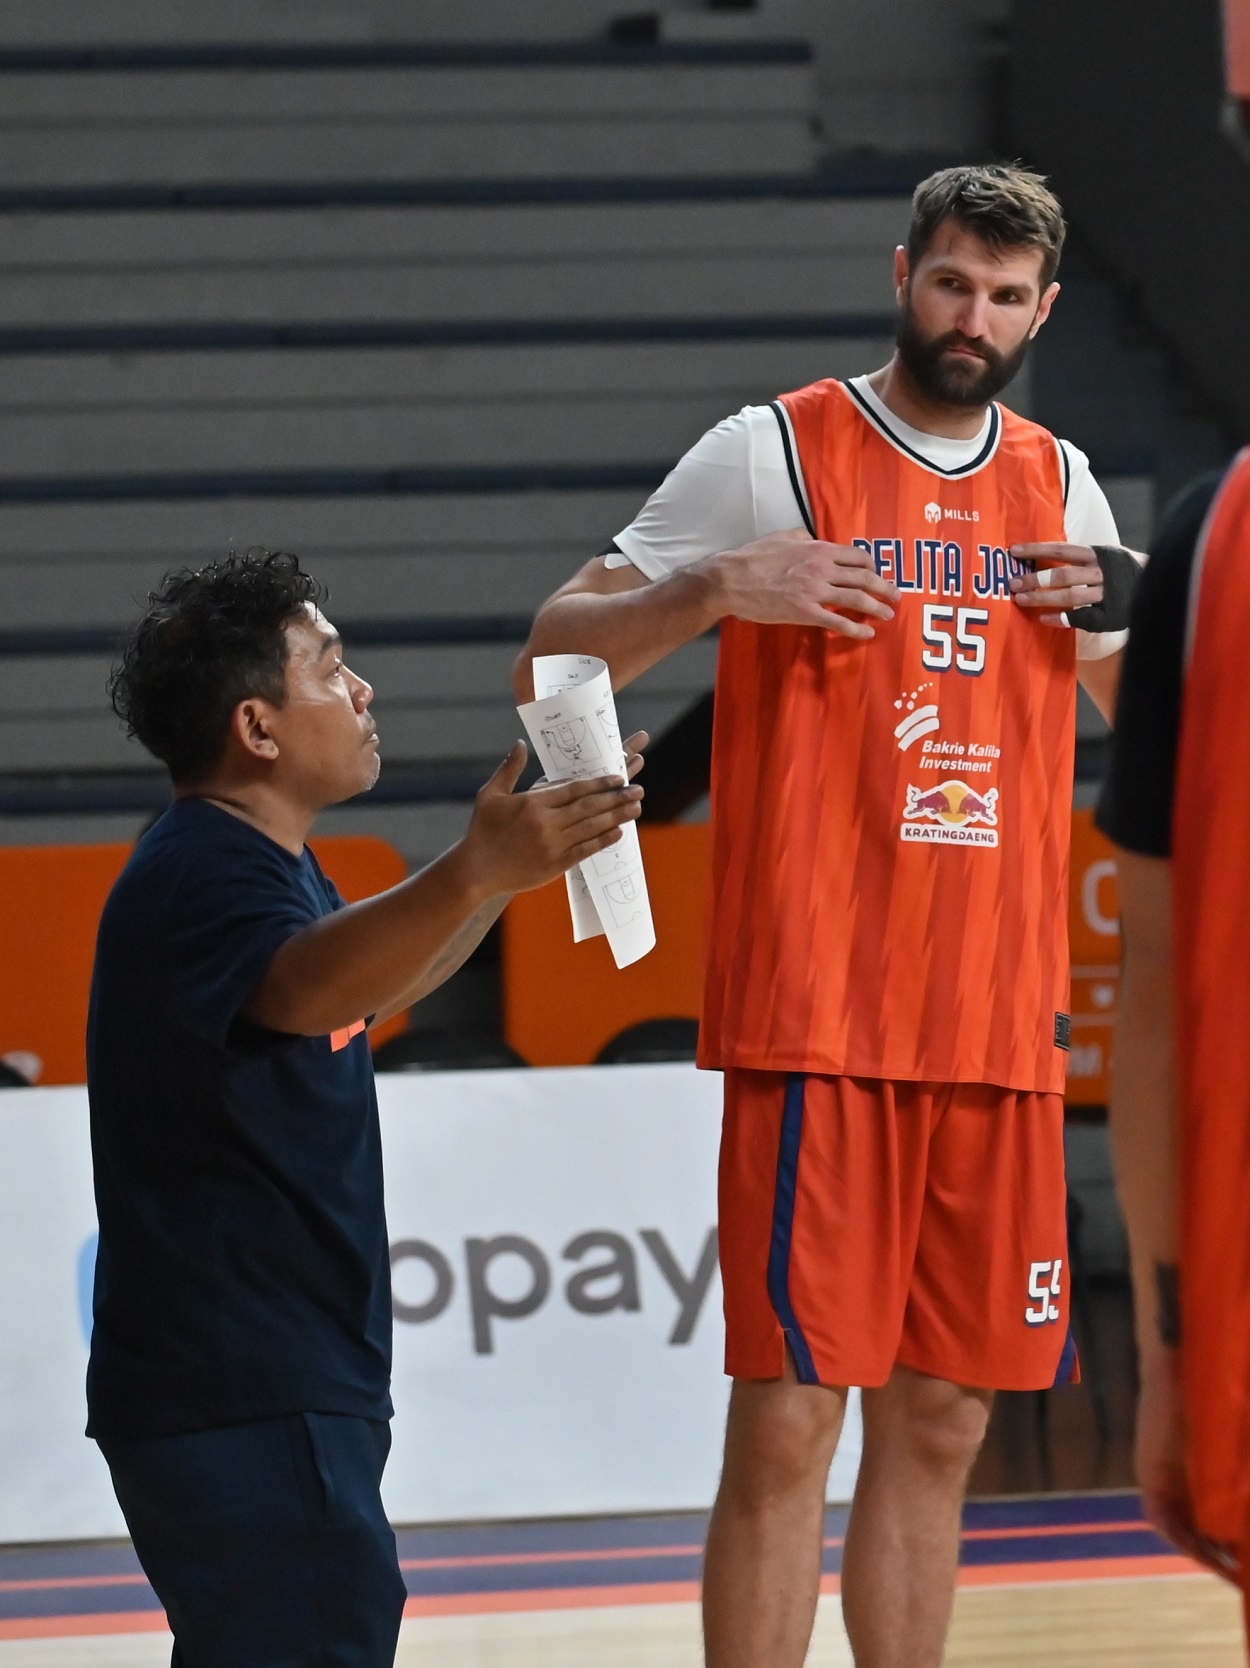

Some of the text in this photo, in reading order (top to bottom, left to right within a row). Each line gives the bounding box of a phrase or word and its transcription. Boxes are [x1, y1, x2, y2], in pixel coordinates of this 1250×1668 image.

[944, 508, 980, 522] MILLS
[921, 602, 989, 677] 55
[922, 740, 1001, 759] Bakrie Kalila
[919, 756, 992, 773] Investment
[904, 827, 995, 843] KRATINGDAENG
[389, 1226, 719, 1356] opay
